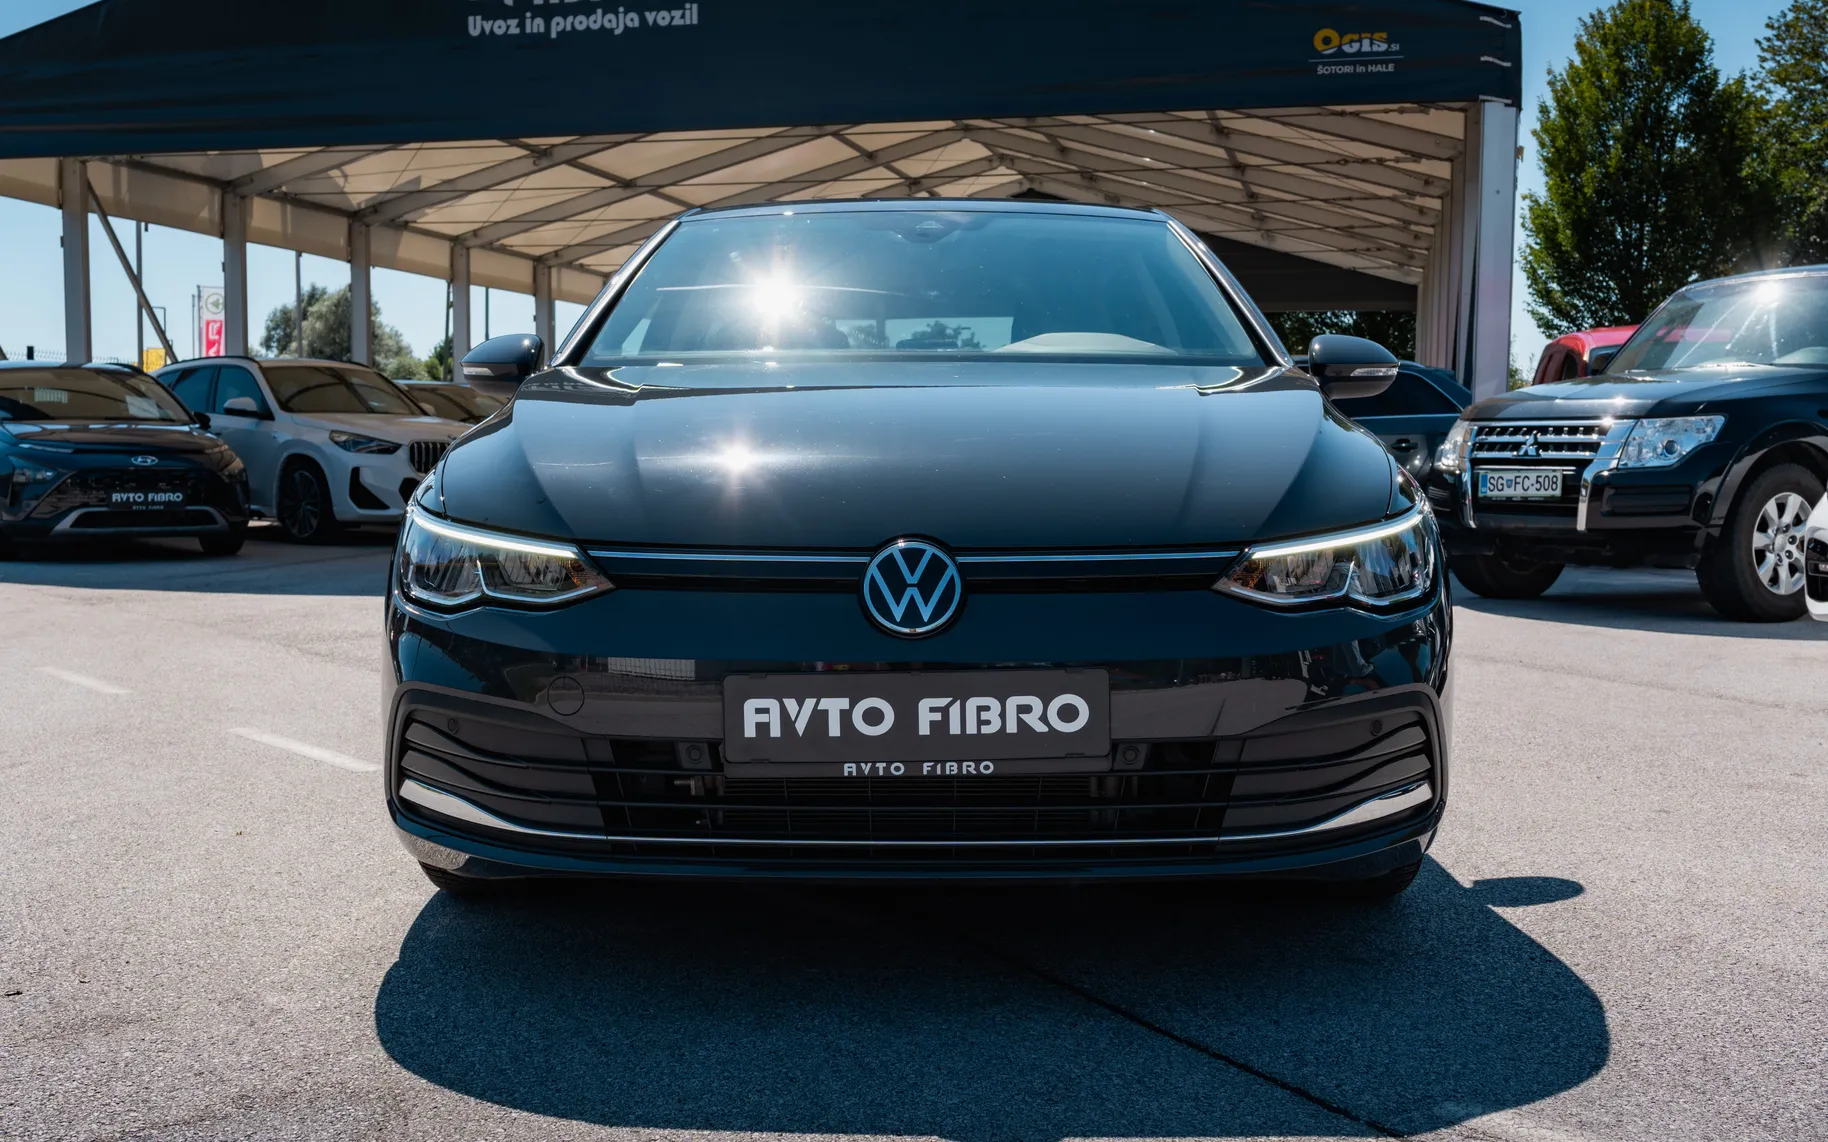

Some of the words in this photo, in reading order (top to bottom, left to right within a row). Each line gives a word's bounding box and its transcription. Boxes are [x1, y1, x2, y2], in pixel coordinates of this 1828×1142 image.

[468, 15, 520, 36] Uvoz
[525, 11, 545, 33] in
[551, 6, 640, 38] prodaja
[644, 3, 698, 26] vozil
[1317, 64, 1354, 75] ŠOTORI
[1356, 64, 1366, 73] in
[1367, 63, 1395, 73] HALE
[1488, 475, 1505, 492] SG
[112, 492, 144, 502] AVTO
[148, 492, 183, 502] FIBRO
[744, 697, 895, 738] AVTO
[918, 693, 1090, 736] FIBRO
[843, 762, 905, 777] AVTO
[923, 760, 994, 775] FIBRO
